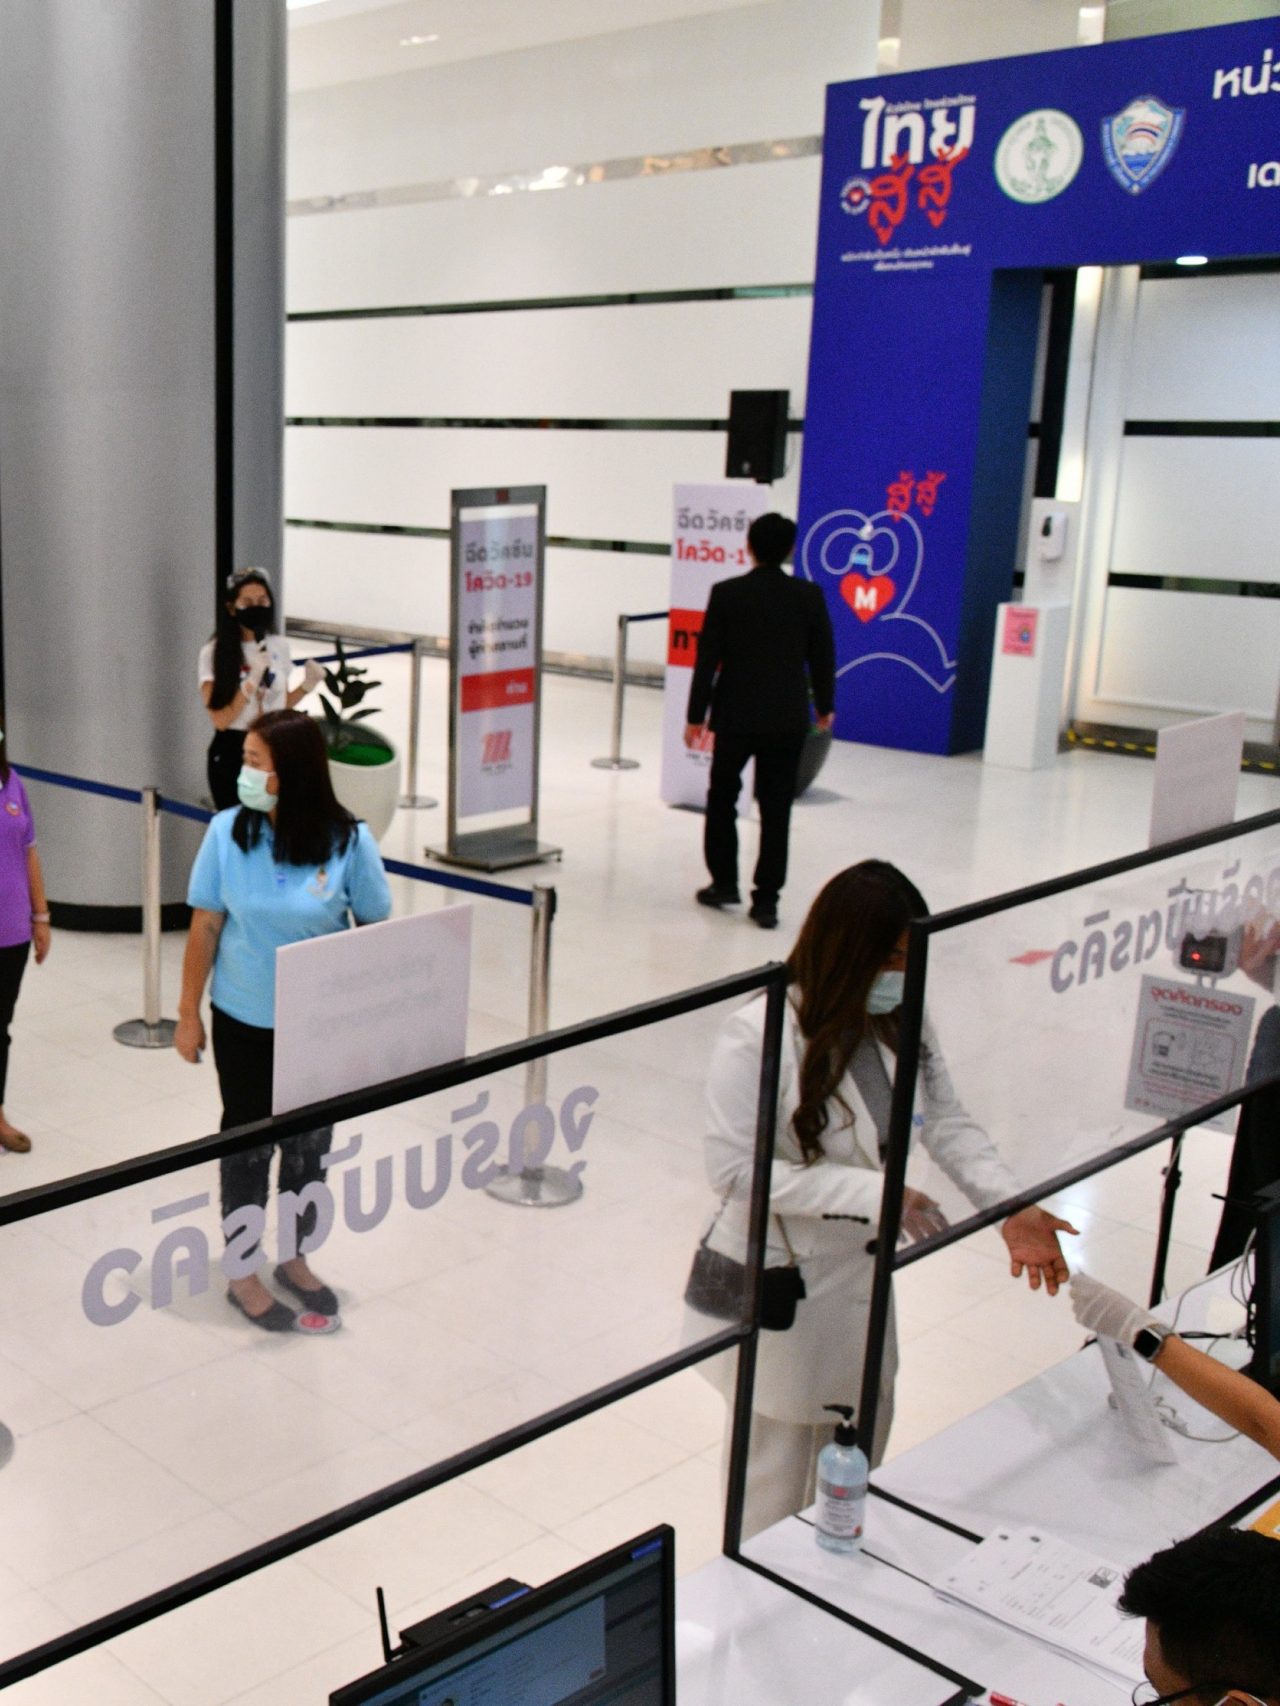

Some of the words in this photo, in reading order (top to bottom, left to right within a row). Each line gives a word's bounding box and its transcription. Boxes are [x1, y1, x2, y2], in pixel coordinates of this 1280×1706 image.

[859, 95, 976, 170] ไทย
[677, 507, 753, 532] ฉีดวัคซี
[677, 537, 750, 565] โควิด-1
[854, 585, 877, 611] M
